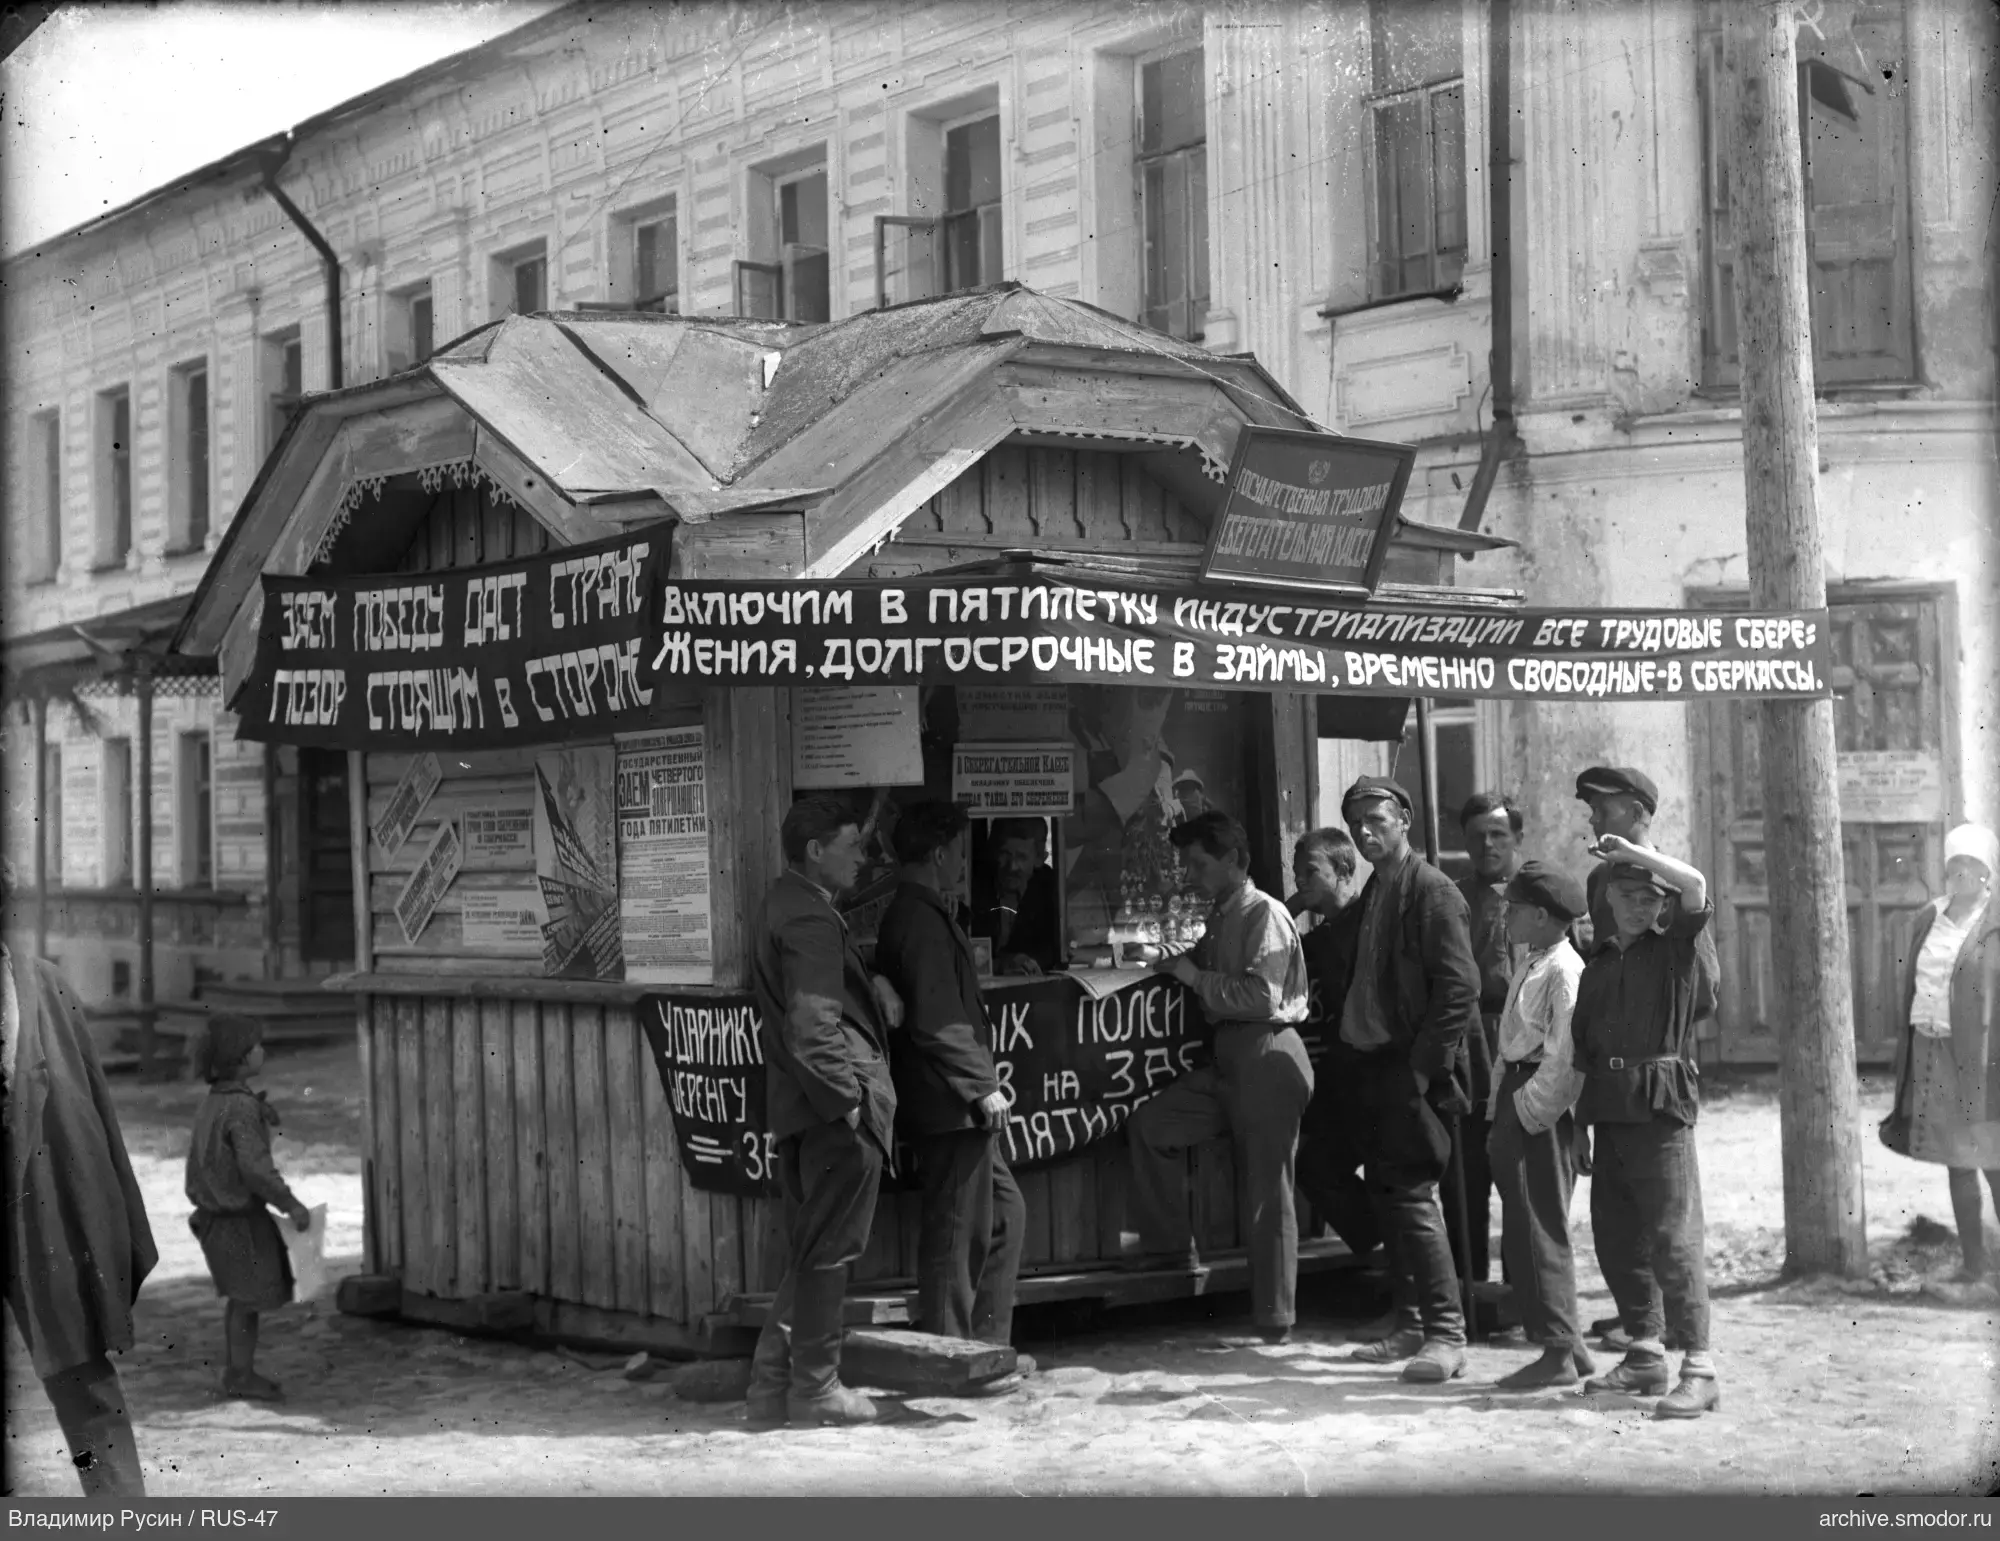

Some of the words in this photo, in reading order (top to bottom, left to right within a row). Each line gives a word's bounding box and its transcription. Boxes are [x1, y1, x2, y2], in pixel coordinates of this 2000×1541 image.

[1236, 467, 1331, 516] ГОСУДАРСТВЕННАЯ
[1329, 482, 1392, 516] ТРУДОВАЯ
[280, 591, 337, 650] ЗАЕМ
[354, 584, 444, 652] ПОБЕДУ
[464, 572, 527, 647] ДАСТ
[550, 542, 649, 629] СТРАНЕ
[663, 586, 852, 625] ВКЛЮЧИМ
[880, 588, 908, 624] В
[929, 585, 1159, 627] ПЯТИЛЕТКУ
[1174, 596, 1525, 648] ИНДУСТРИАЛИЗАЦИИ
[1533, 618, 1584, 648] ВСЕ
[1600, 619, 1722, 652] ТРУДОВЫЕ
[269, 669, 346, 726] ПОЗОР
[367, 667, 484, 737] СТОЯЩИМ
[494, 677, 519, 728] В
[524, 637, 654, 722] СТОРОНЕ
[651, 631, 814, 678] ЖЕНИЯ,
[819, 636, 1154, 680] ДОЛГОСРОЧНЫЕ
[1173, 641, 1195, 677] В
[1213, 642, 1340, 689] ЗАЙМЫ,
[1345, 651, 1495, 689] ВРЕМЕННО
[1692, 660, 1823, 692] СБЕРКАССЫ.
[618, 748, 704, 769] ГОСУДАРСТВЕННЫЙ
[619, 770, 650, 807] ЗАЕМ
[652, 765, 704, 784] ЧЕТВЕРТОГО
[620, 821, 646, 839] ГОДА
[649, 816, 706, 836] ПЯТИЛЕТКИ
[657, 1000, 763, 1066] УДАРНИКИ
[1044, 1070, 1080, 1102] НА
[1103, 1040, 1203, 1099] ЗАЕ
[1006, 1090, 1161, 1161] ПЯТИЛ
